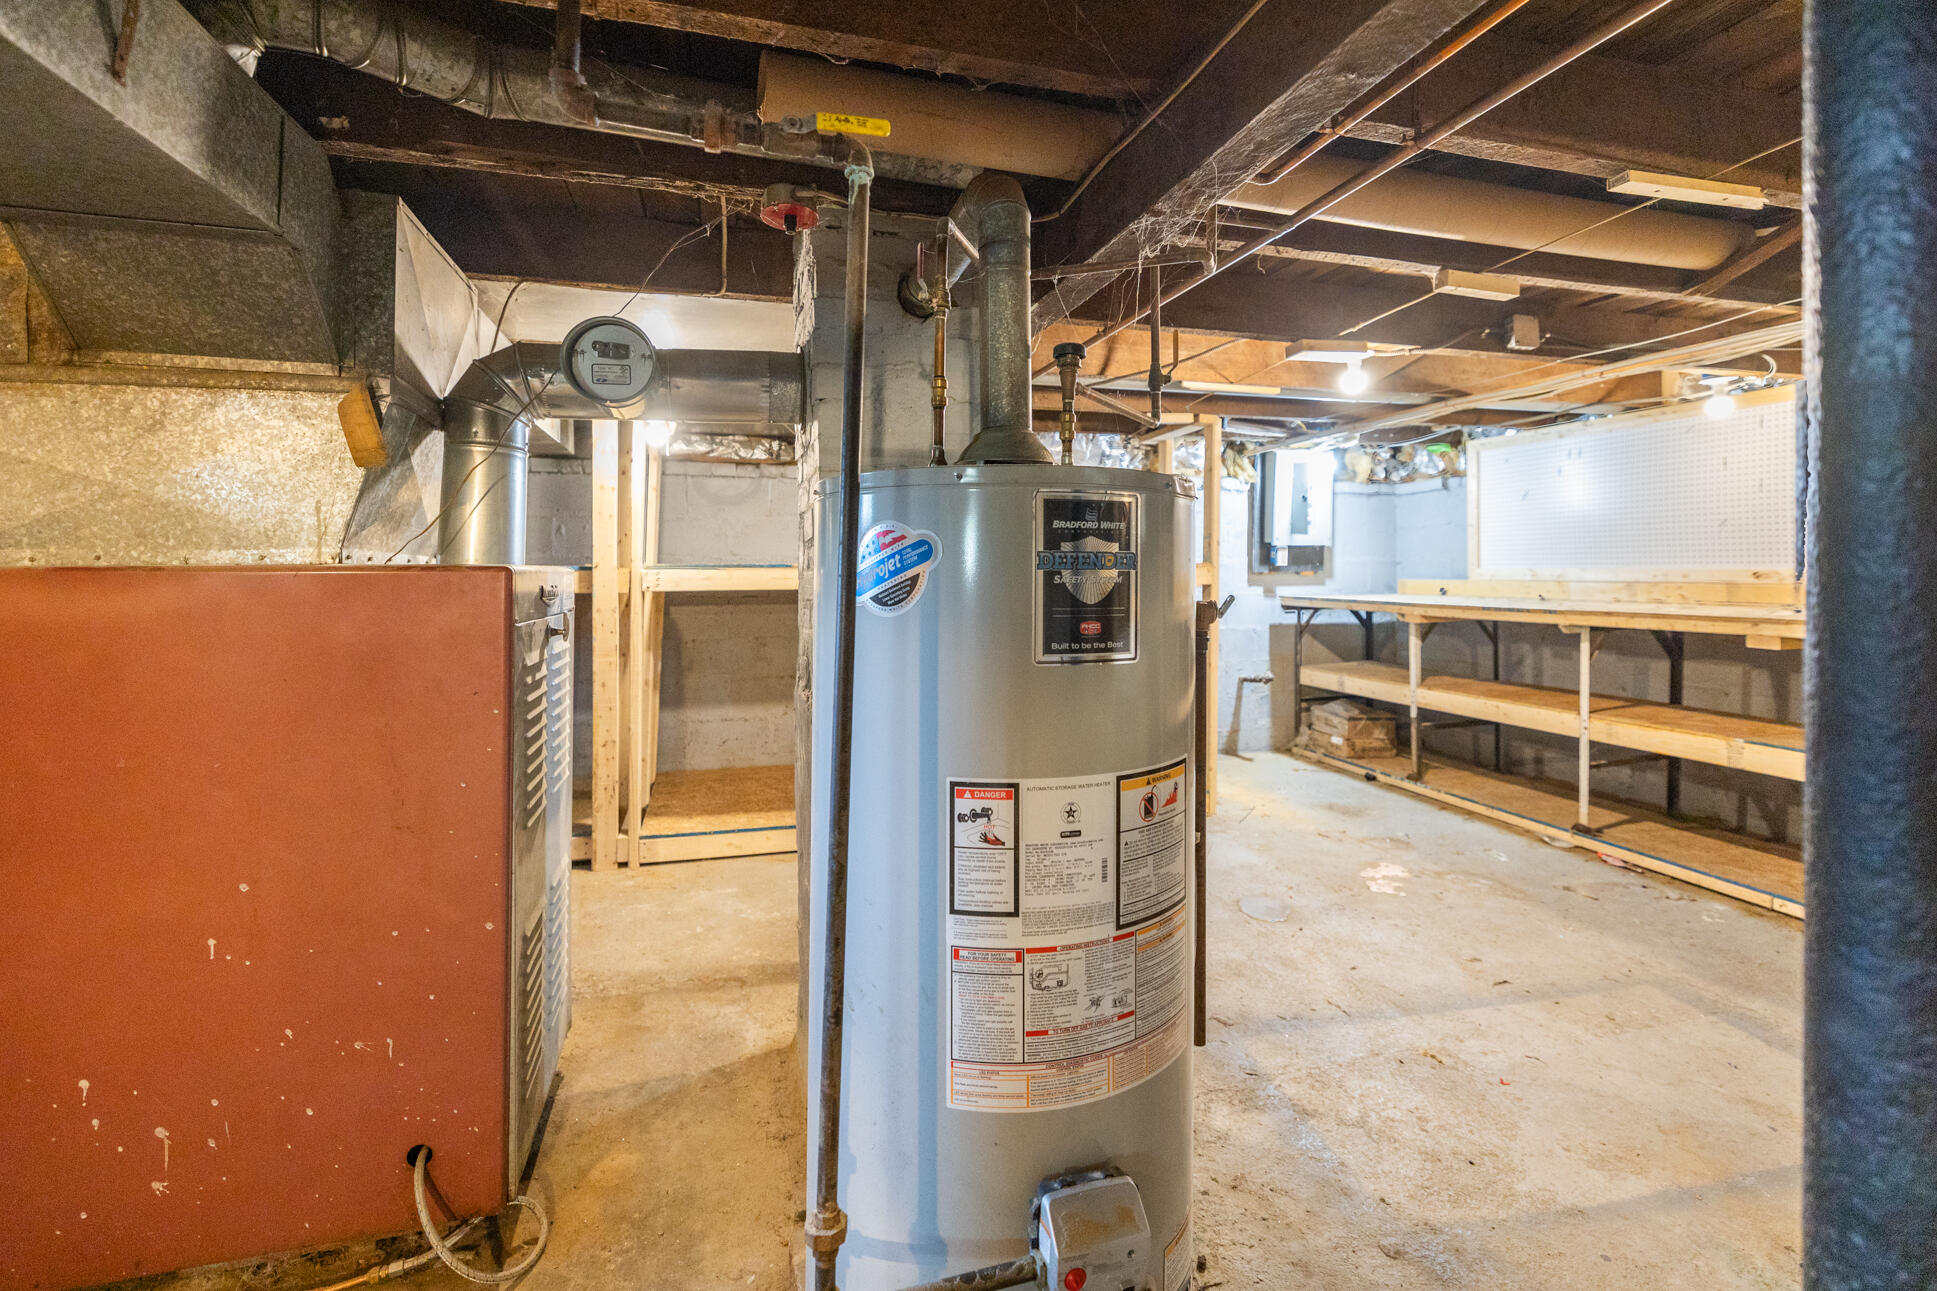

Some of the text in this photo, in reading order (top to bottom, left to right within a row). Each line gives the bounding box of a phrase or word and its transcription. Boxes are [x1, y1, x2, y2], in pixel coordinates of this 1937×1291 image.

[1052, 520, 1126, 530] BRADFORD WHITE
[1036, 551, 1137, 570] DEFENDER
[1053, 575, 1086, 584] SAFETY
[1051, 642, 1070, 650] Built
[1071, 642, 1079, 650] to
[1094, 641, 1106, 649] the
[1107, 641, 1124, 649] Best
